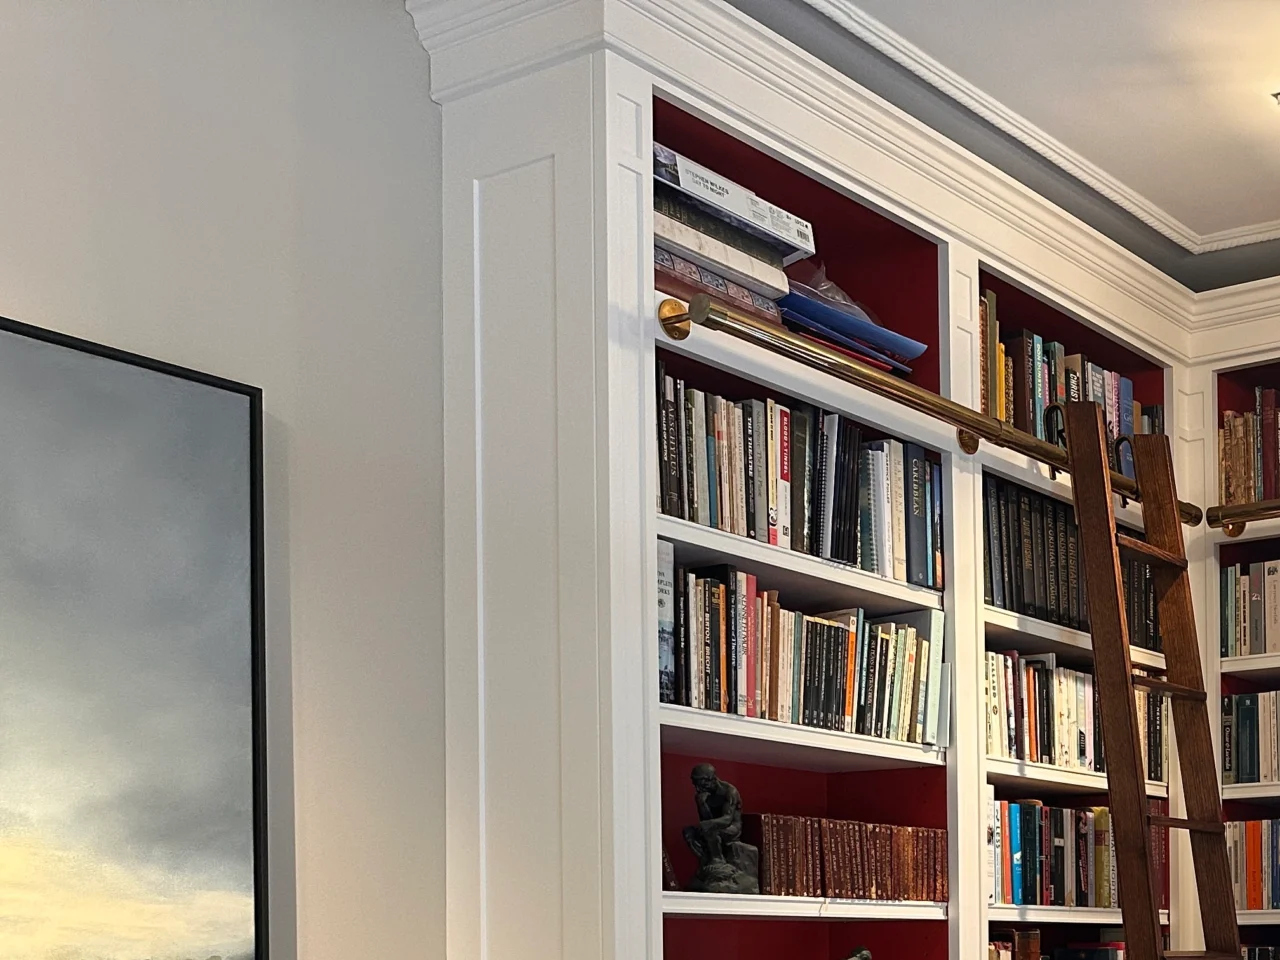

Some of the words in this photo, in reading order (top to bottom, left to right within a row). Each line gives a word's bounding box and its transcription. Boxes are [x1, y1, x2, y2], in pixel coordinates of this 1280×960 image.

[684, 168, 710, 185] STEPHEN
[709, 180, 730, 195] WILKES
[702, 182, 710, 191] TO
[709, 186, 725, 198] NIGHT
[668, 404, 677, 477] AESCHYLUS
[912, 458, 920, 517] CARIBBEAN
[1057, 510, 1065, 531] JOHN
[1023, 538, 1033, 571] GRISHAM
[1048, 527, 1056, 569] GRISHAM
[1058, 532, 1067, 566] GRISHAM
[1049, 570, 1057, 610] TESTAMENT
[1110, 865, 1118, 908] NORTON
